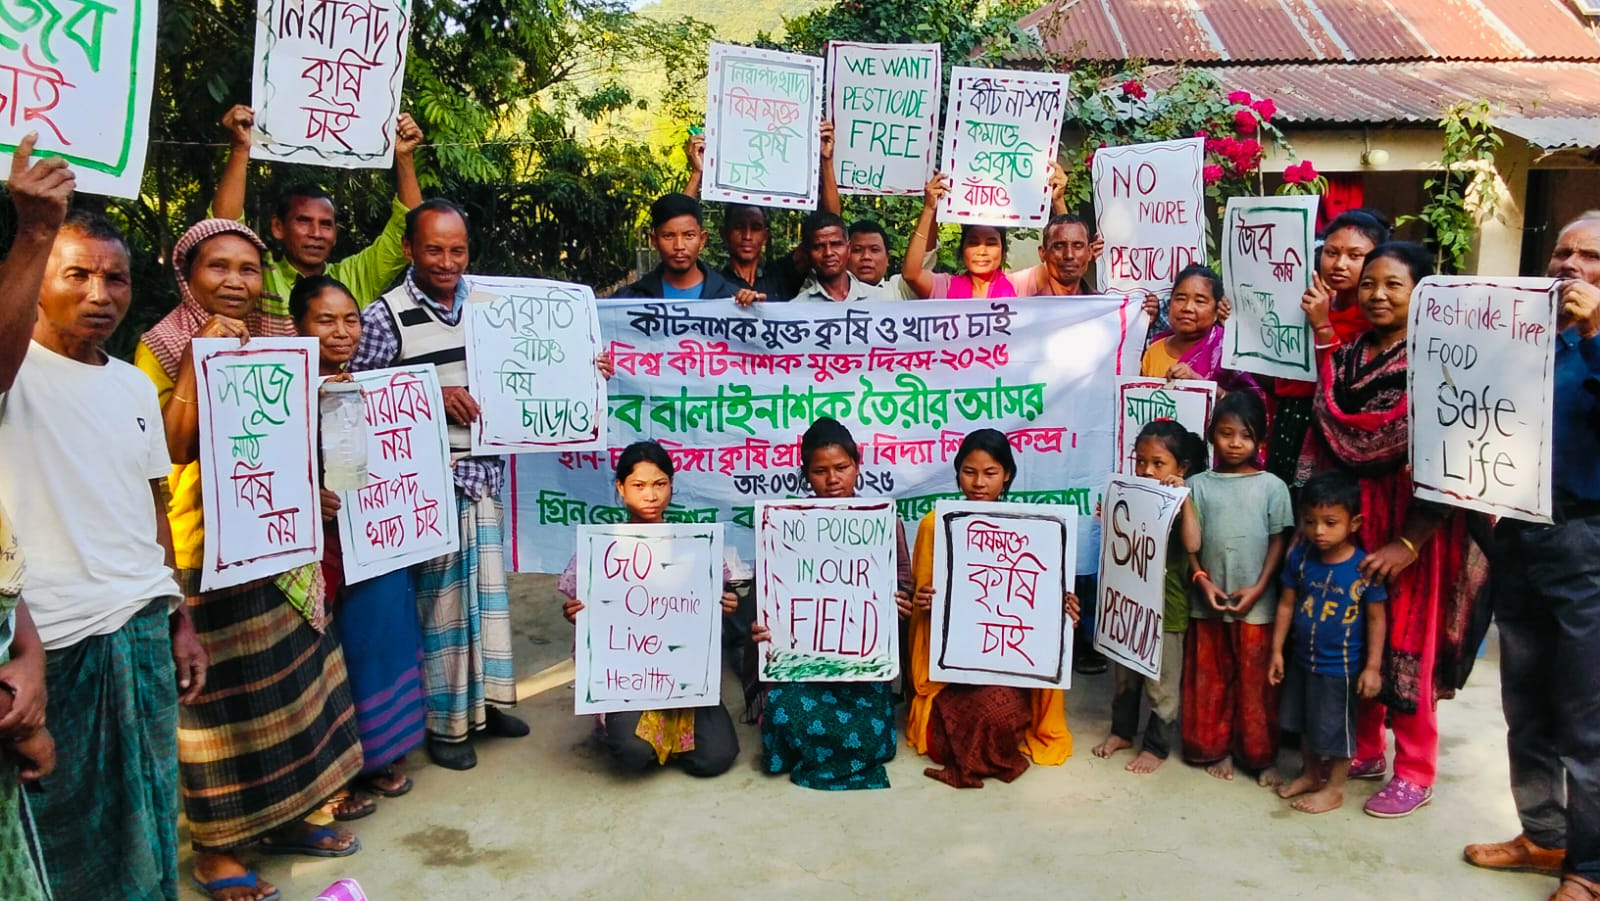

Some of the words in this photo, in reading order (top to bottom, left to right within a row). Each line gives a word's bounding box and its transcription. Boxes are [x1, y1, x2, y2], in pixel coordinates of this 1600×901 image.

[301, 47, 384, 106] কৃষি
[843, 55, 877, 76] WE
[881, 56, 932, 80] WANT
[299, 95, 361, 151] চাই
[842, 85, 929, 119] PESTICIDE
[743, 125, 804, 163] কৃষি
[849, 119, 923, 158] FREE
[724, 154, 769, 188] চাই
[840, 160, 886, 189] Field
[968, 141, 1043, 185] প্রকৃতি
[1112, 162, 1157, 199] NO
[961, 175, 1011, 208] বাঁচাও
[1139, 200, 1189, 225] MORE
[1235, 210, 1276, 262] জৈব
[482, 288, 580, 337] প্রকৃতি
[627, 302, 757, 343] কীটনাশক
[762, 319, 811, 350] মুক্ত
[814, 308, 873, 350] কৃষি
[875, 317, 898, 344] ও
[902, 314, 960, 342] খাদ্য
[965, 302, 1018, 338] চাই
[1260, 310, 1304, 358] জীবন
[607, 340, 664, 377] বিশ্ব
[666, 339, 802, 378] কীটনাশক
[807, 353, 865, 383] মুক্ত
[1427, 337, 1478, 370] FOOD
[217, 362, 294, 425] সবুজ
[493, 358, 537, 396] বিষ
[649, 383, 856, 436] বালাইনাশক
[857, 373, 952, 430] তৈরীর
[953, 375, 1048, 422] আসর
[374, 427, 413, 463] নয়
[717, 437, 771, 477] কৃষি
[873, 432, 936, 466] বিদ্যা
[229, 460, 276, 511] বিষ
[1441, 439, 1518, 498] Life
[356, 471, 421, 514] নিরাপদ
[536, 489, 588, 526] গ্রিন
[258, 507, 300, 546] নয়
[365, 514, 406, 550] খাদ্য
[412, 490, 443, 539] চাই
[782, 519, 807, 543] NO
[816, 516, 887, 546] POISON
[603, 540, 653, 583] GO
[966, 551, 1048, 614] কৃষি
[625, 584, 702, 621] Organic
[608, 624, 663, 655] Live
[790, 597, 879, 658] FIELD
[975, 604, 1035, 667] চাই
[1102, 586, 1162, 668] PESTICIDE
[606, 666, 677, 700] Healthy
